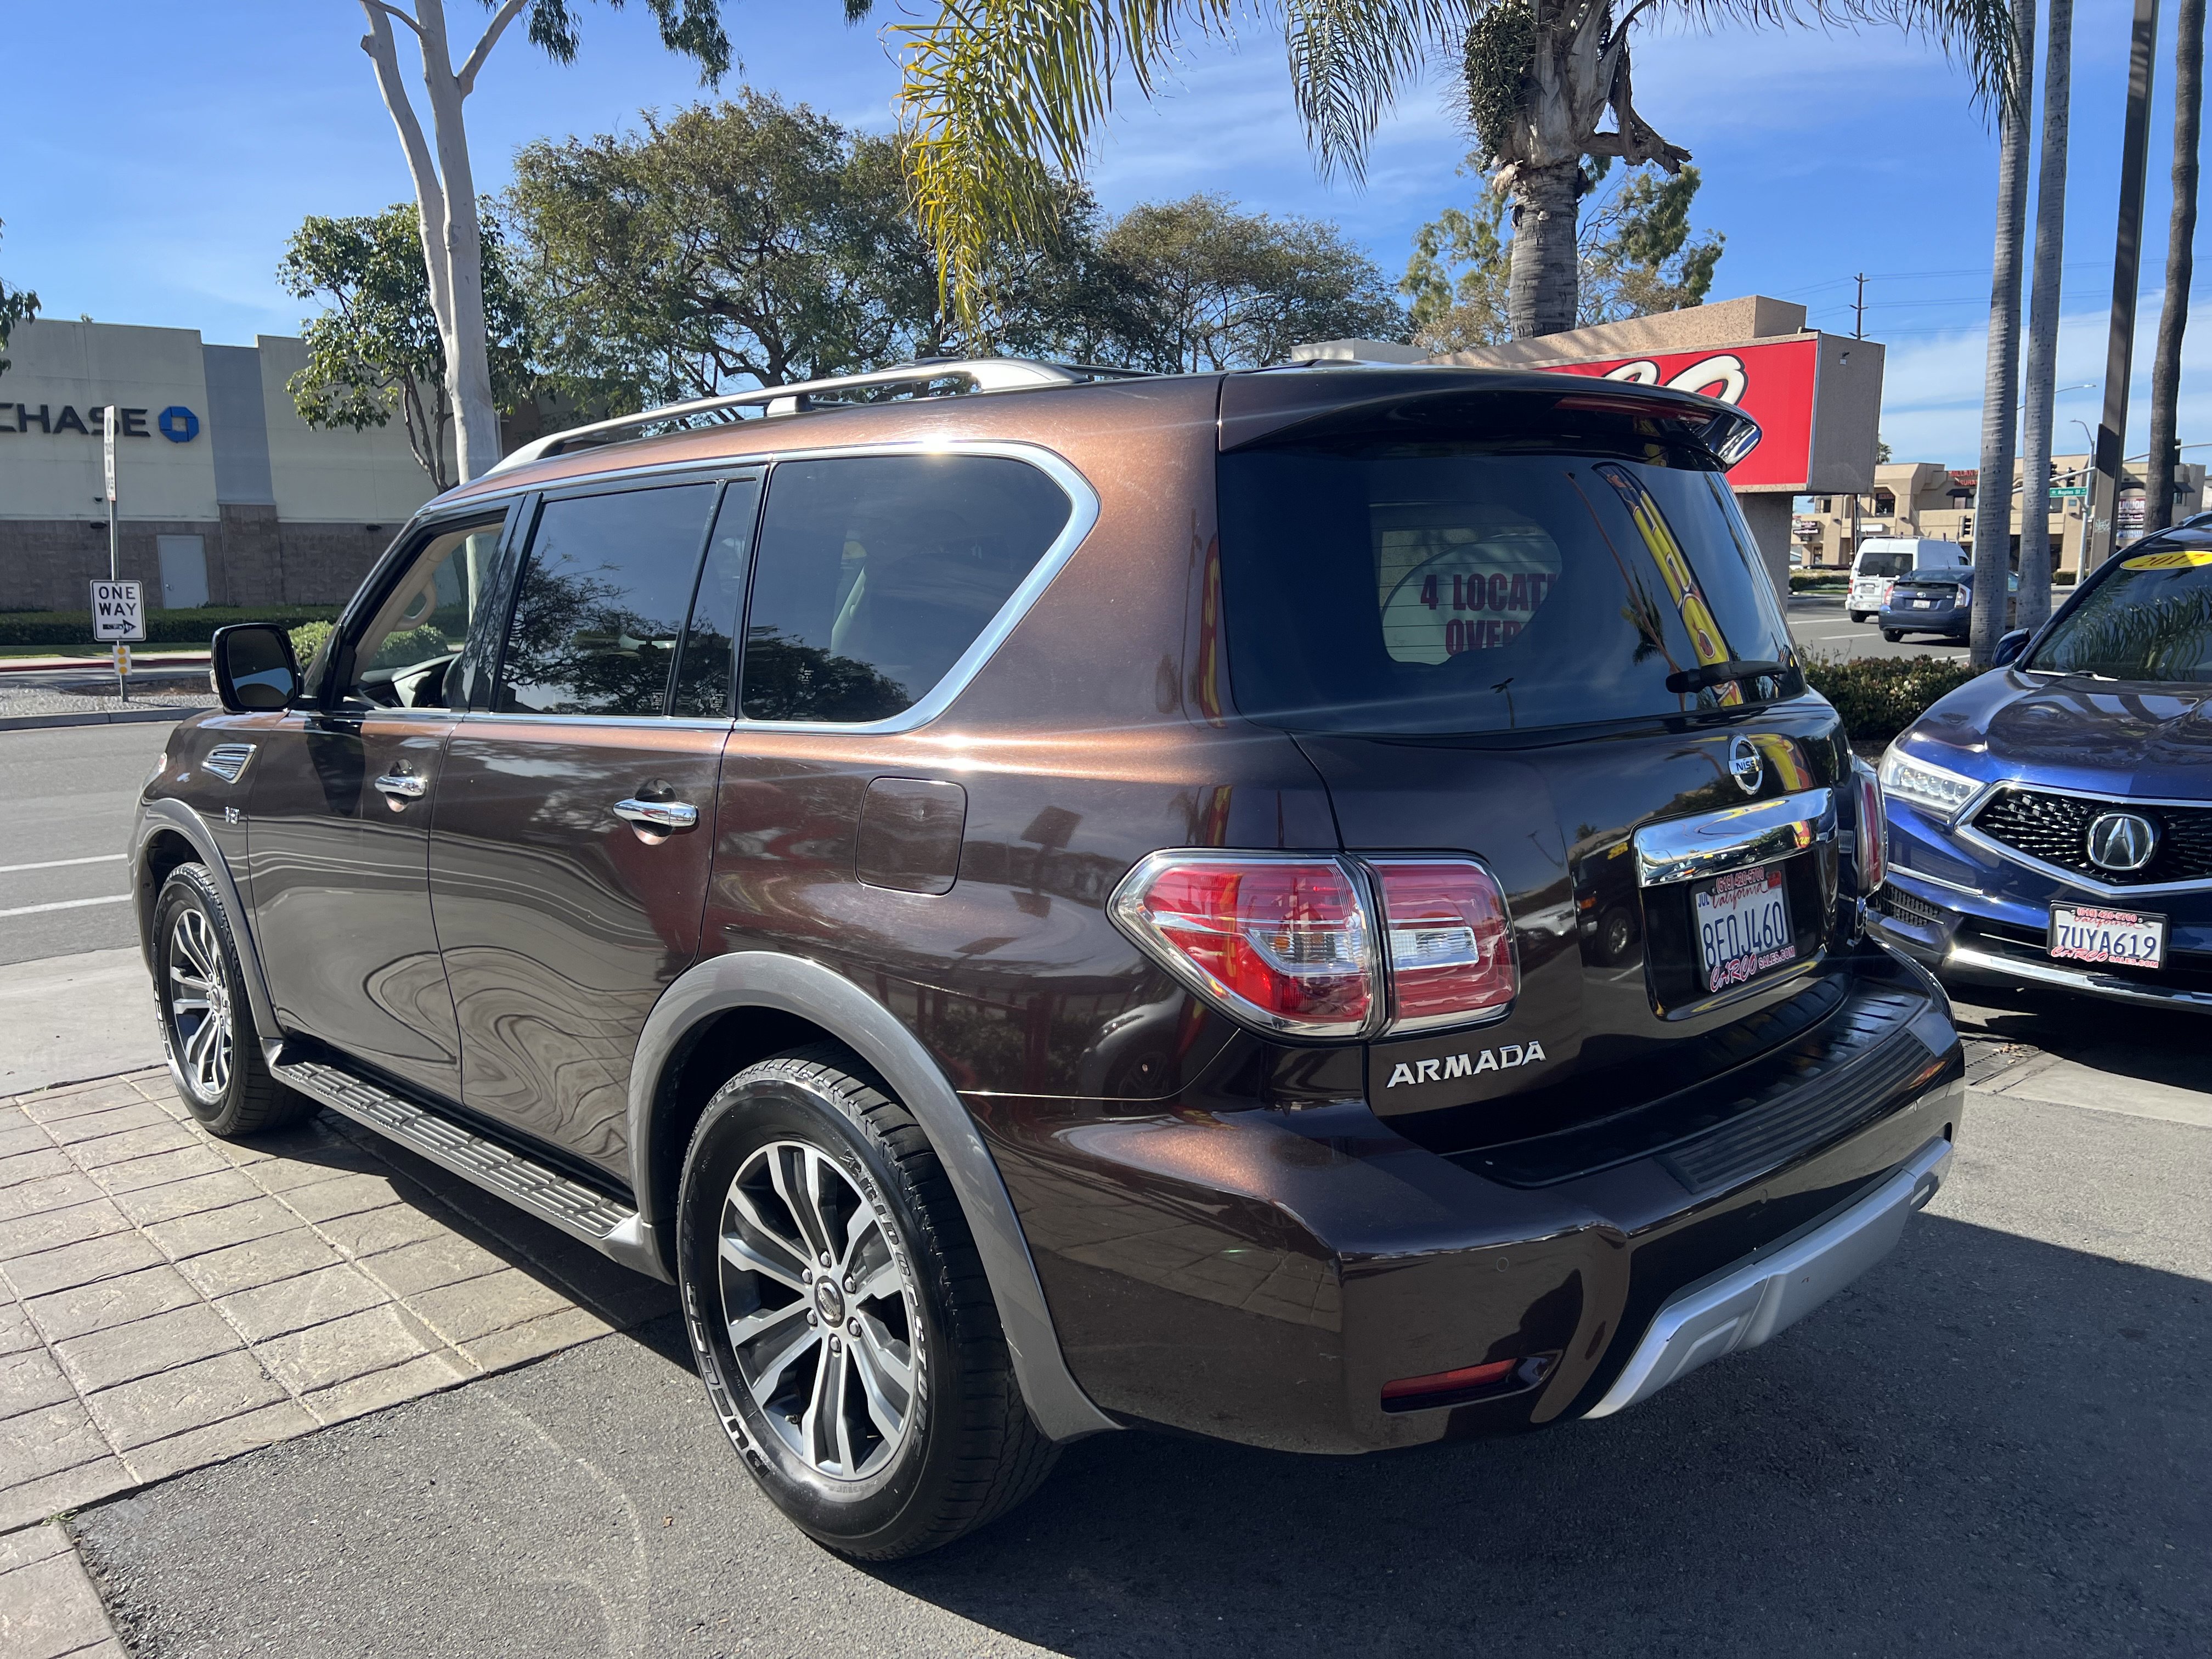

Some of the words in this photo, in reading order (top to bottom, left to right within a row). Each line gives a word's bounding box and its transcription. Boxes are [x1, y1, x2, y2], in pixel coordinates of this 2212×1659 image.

[2119, 500, 2145, 510] LIQUOR
[99, 586, 136, 600] ONE
[1420, 574, 1438, 610] 4
[99, 602, 137, 616] WAY
[1716, 873, 1734, 894] (619)
[1735, 866, 1764, 887] 420-5700
[1698, 893, 1709, 908] JUL
[1712, 883, 1769, 910] California
[2076, 907, 2098, 918] (619)
[2098, 910, 2137, 922] 420-5700
[2058, 924, 2157, 959] 7UYA619
[1758, 946, 1796, 969] SALES.COM
[2109, 955, 2159, 969] SALES.COM
[1386, 1041, 1547, 1088] ARMADA
